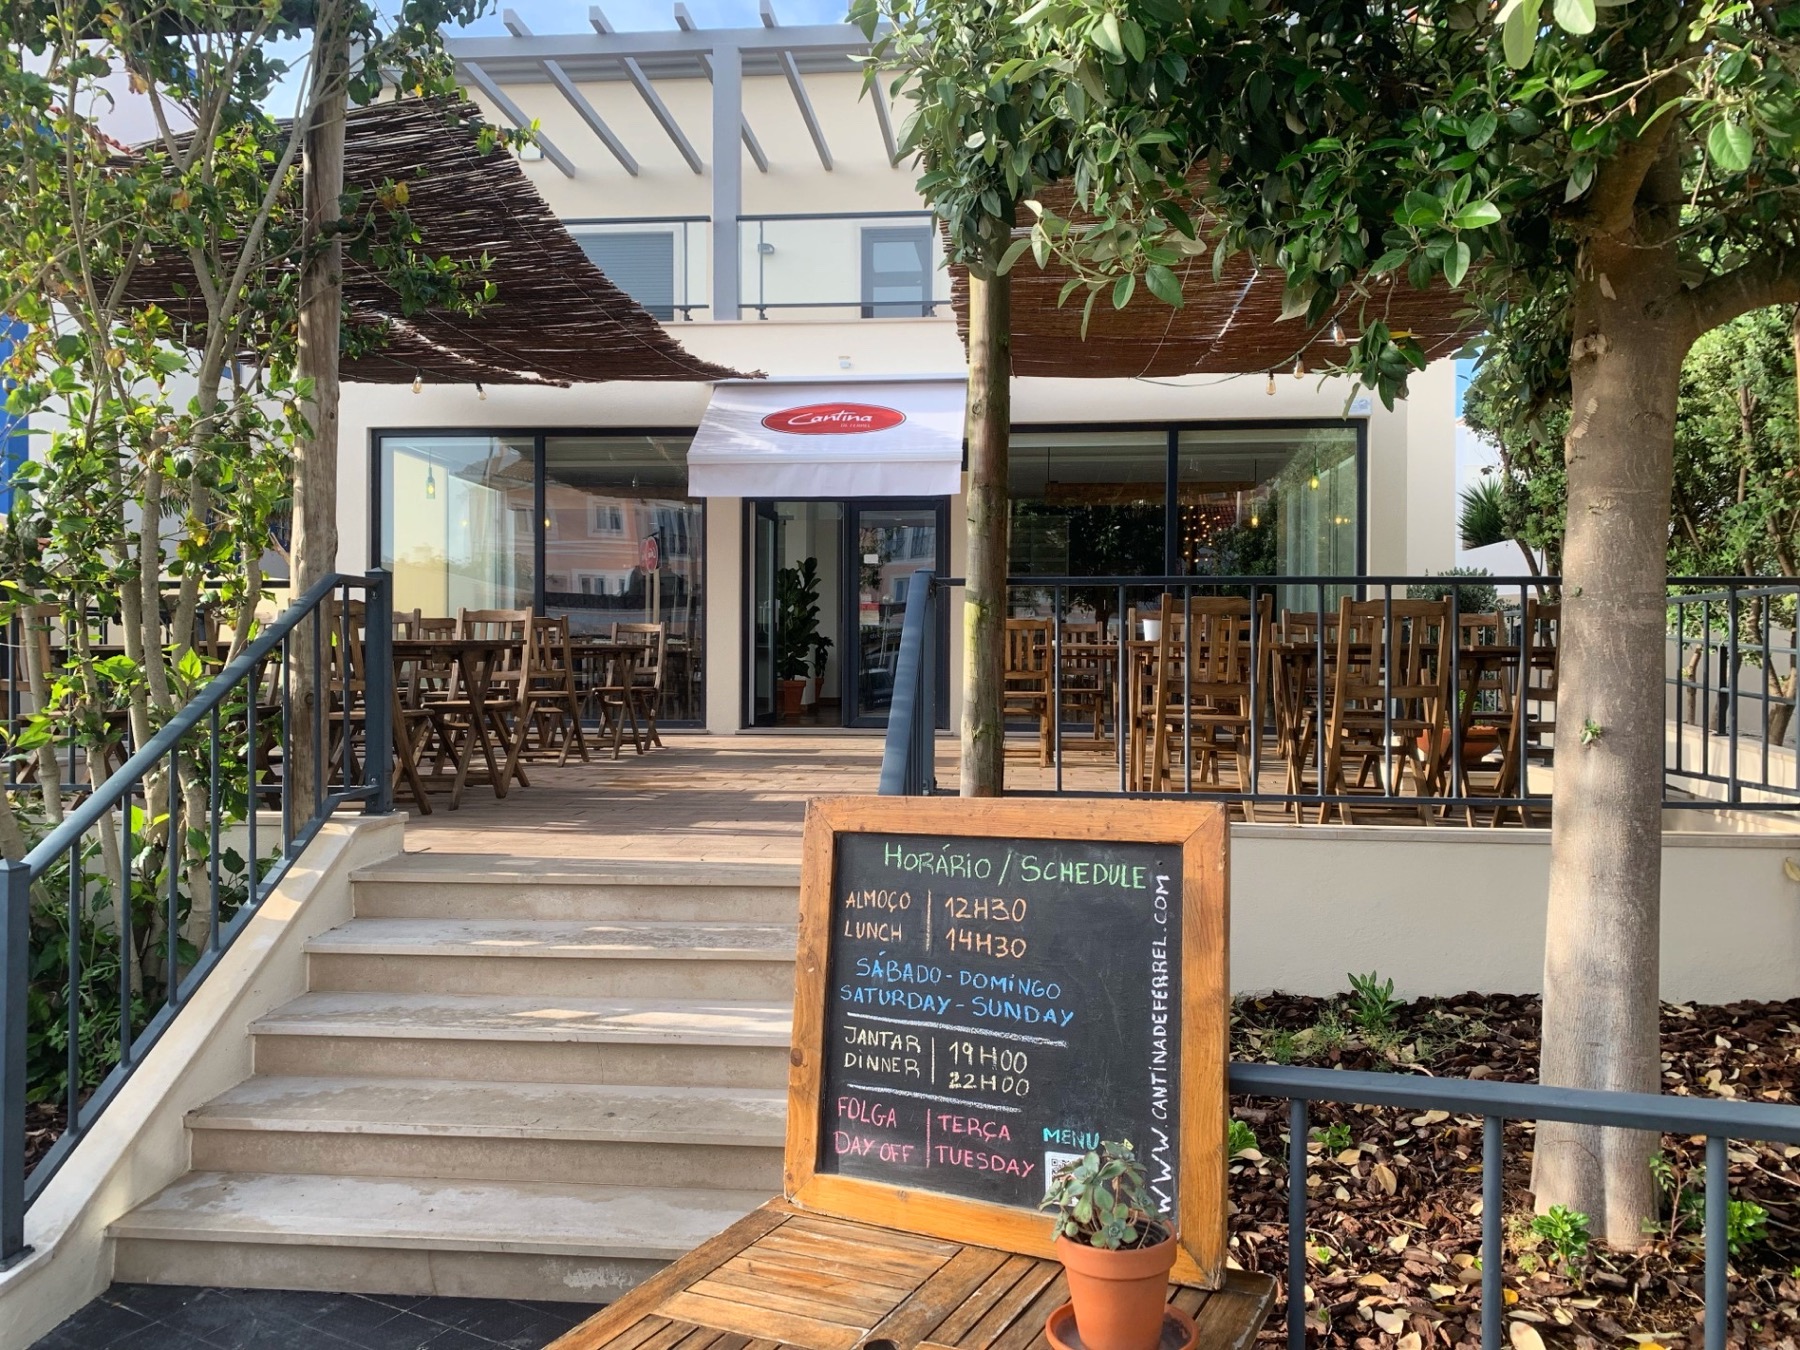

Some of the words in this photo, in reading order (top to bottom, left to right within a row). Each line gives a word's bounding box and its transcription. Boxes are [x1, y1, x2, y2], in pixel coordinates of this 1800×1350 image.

[788, 409, 873, 426] Cantina
[884, 842, 992, 879] HORÁRIO
[1020, 855, 1147, 890] SCHEDULE
[845, 890, 912, 914] ALMOÇO
[945, 896, 1027, 923] 12H30
[844, 920, 903, 943] LUNCH
[945, 928, 1027, 958] 14H30
[855, 951, 942, 984] SÁBADO
[959, 972, 1062, 1001] DOMINGO
[840, 985, 952, 1016] SATURDAY
[972, 996, 1075, 1028] SUNDAY
[843, 1026, 922, 1055] JANTAR
[948, 1041, 1029, 1075] 19H00
[1149, 874, 1172, 1213] WWW.CANTINADEFERREL.COM
[843, 1050, 921, 1079] DINNER
[948, 1071, 1031, 1097] 22H00
[836, 1097, 898, 1128] FOLGA
[937, 1114, 1012, 1143] TERÇA
[1042, 1127, 1100, 1151] MENU
[833, 1131, 873, 1157] DAY
[878, 1143, 914, 1164] OFF
[935, 1145, 1036, 1178] TUESDAY
